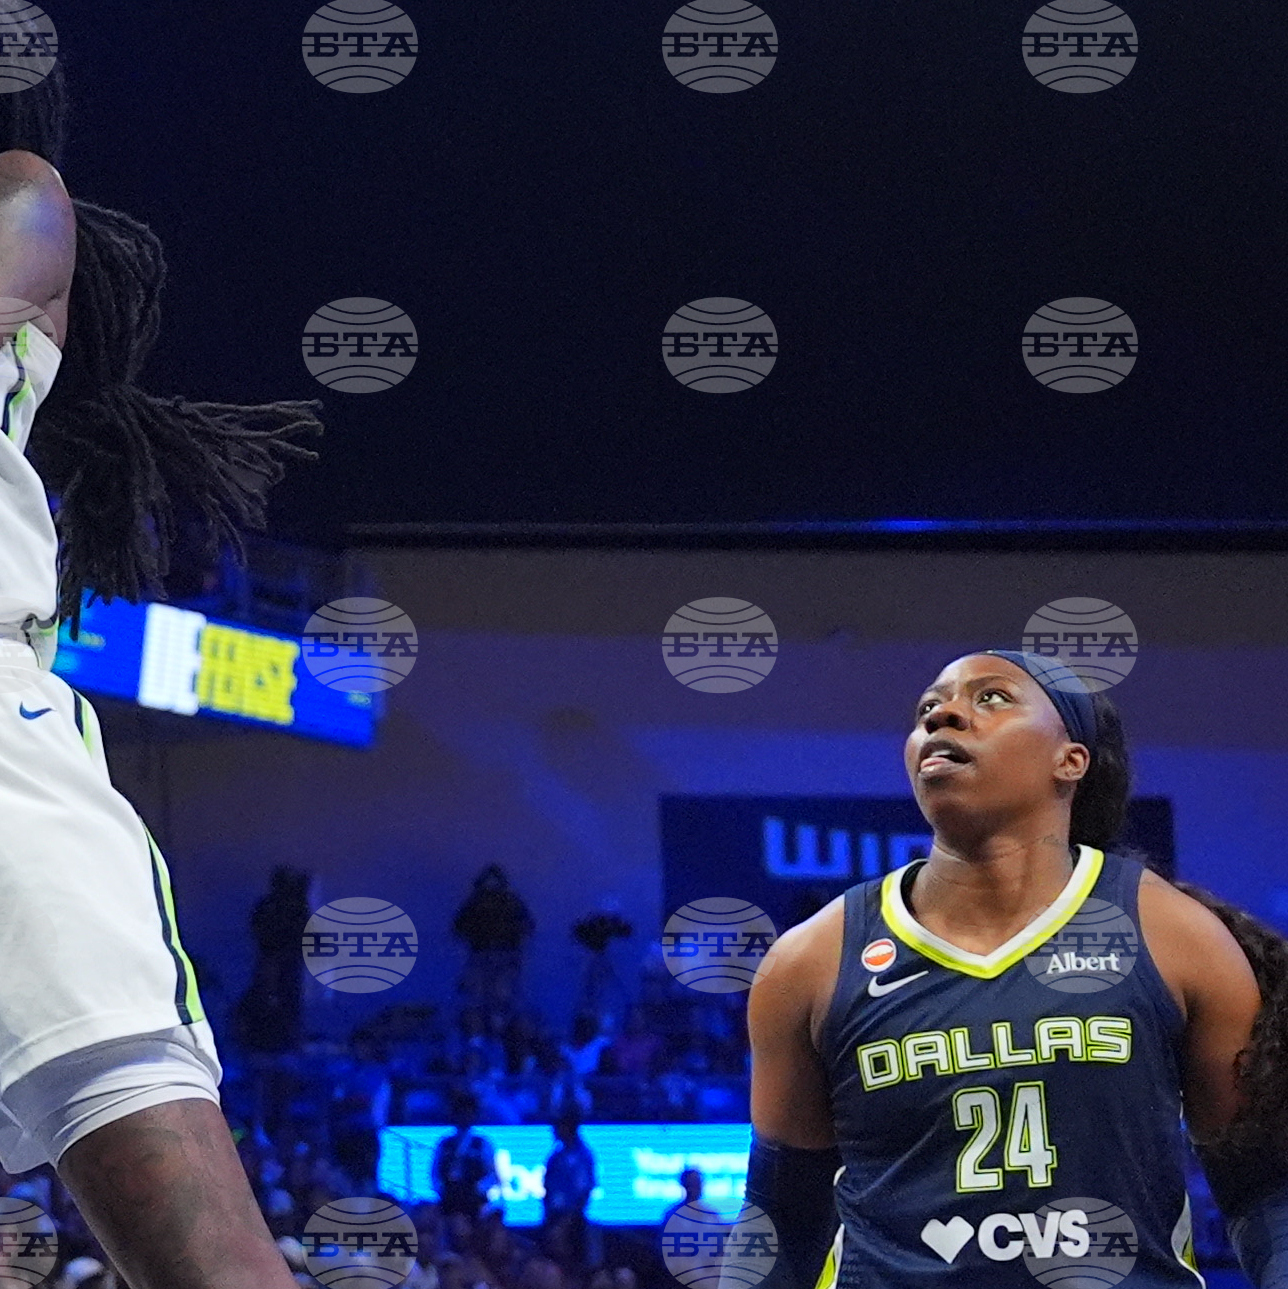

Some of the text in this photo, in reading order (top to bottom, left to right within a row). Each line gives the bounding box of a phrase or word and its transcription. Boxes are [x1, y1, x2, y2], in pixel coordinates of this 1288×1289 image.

[1046, 951, 1120, 975] Albert
[857, 1015, 1133, 1092] DALLAS
[952, 1080, 1058, 1193] 24
[978, 1209, 1091, 1262] CVS
